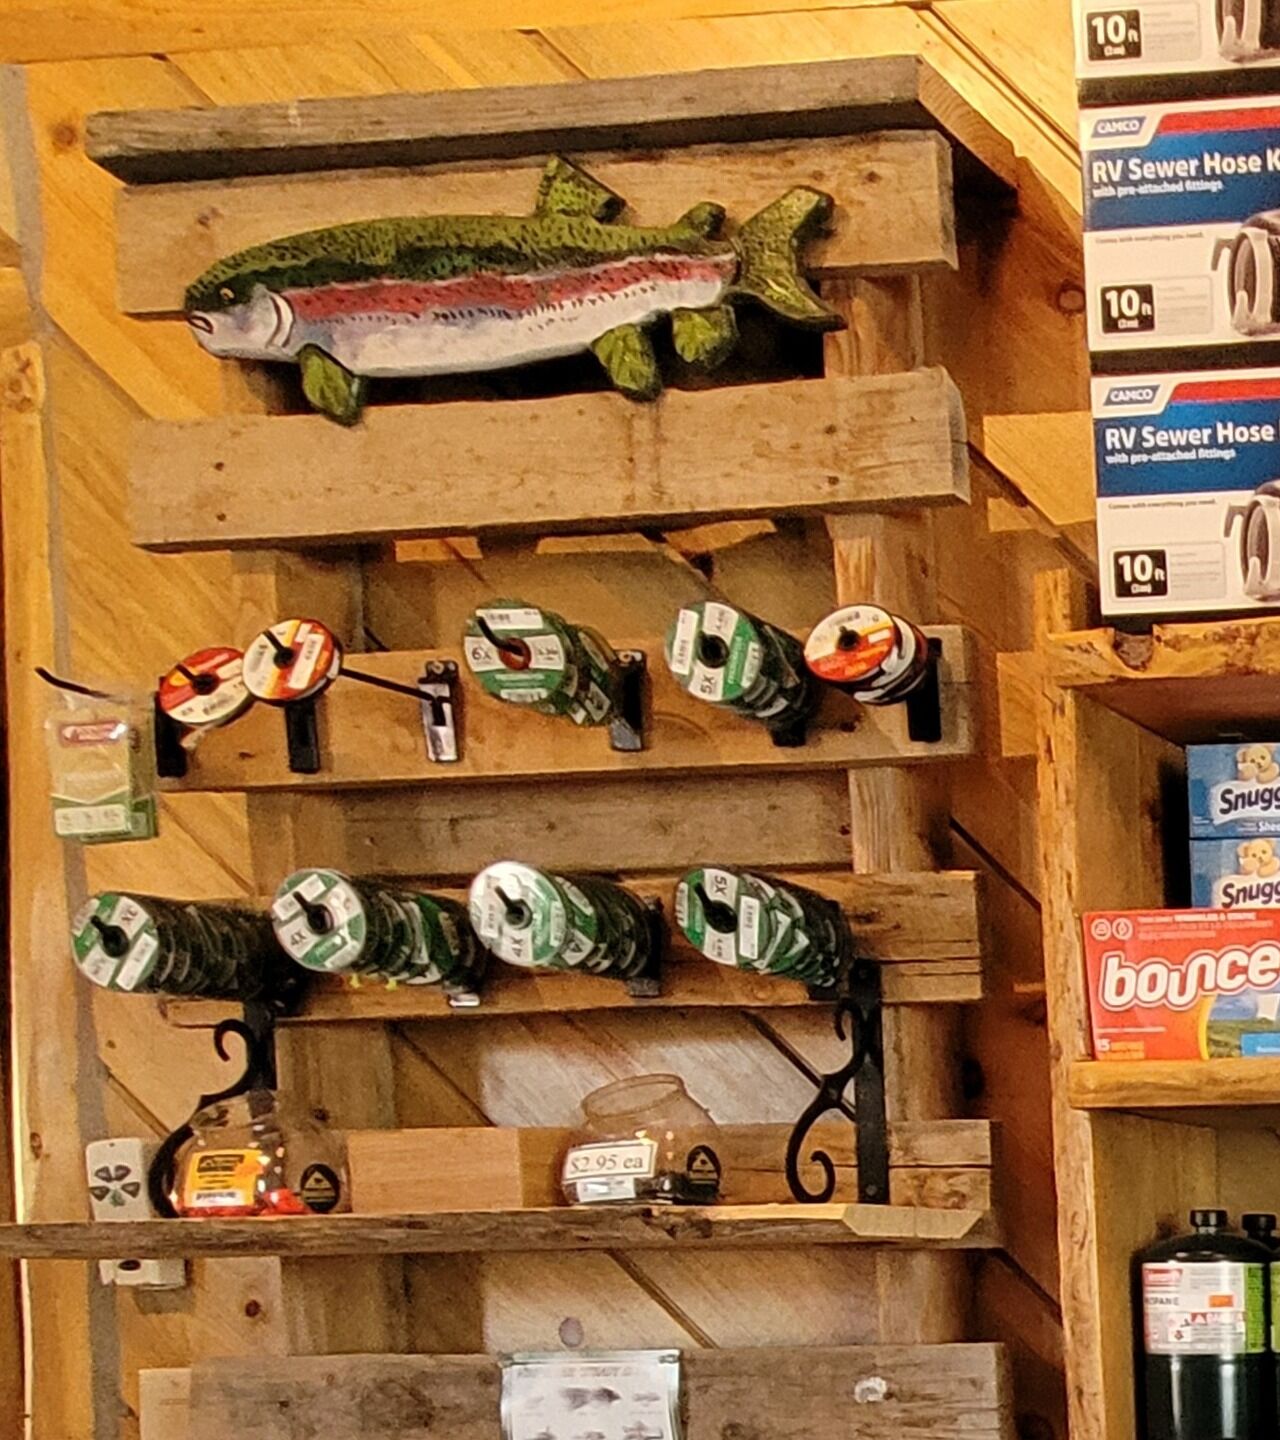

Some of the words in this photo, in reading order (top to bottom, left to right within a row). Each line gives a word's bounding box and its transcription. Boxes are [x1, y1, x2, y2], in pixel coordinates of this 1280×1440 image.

[1092, 159, 1123, 183] RV
[1127, 155, 1199, 180] Sewer
[1203, 152, 1262, 176] Hose
[1105, 289, 1141, 319] 10
[1105, 427, 1135, 450] RV
[1140, 424, 1212, 448] Sewer
[1216, 421, 1275, 443] Hose
[1118, 554, 1153, 583] 10
[713, 875, 728, 895] 5X
[622, 1156, 644, 1170] ea
